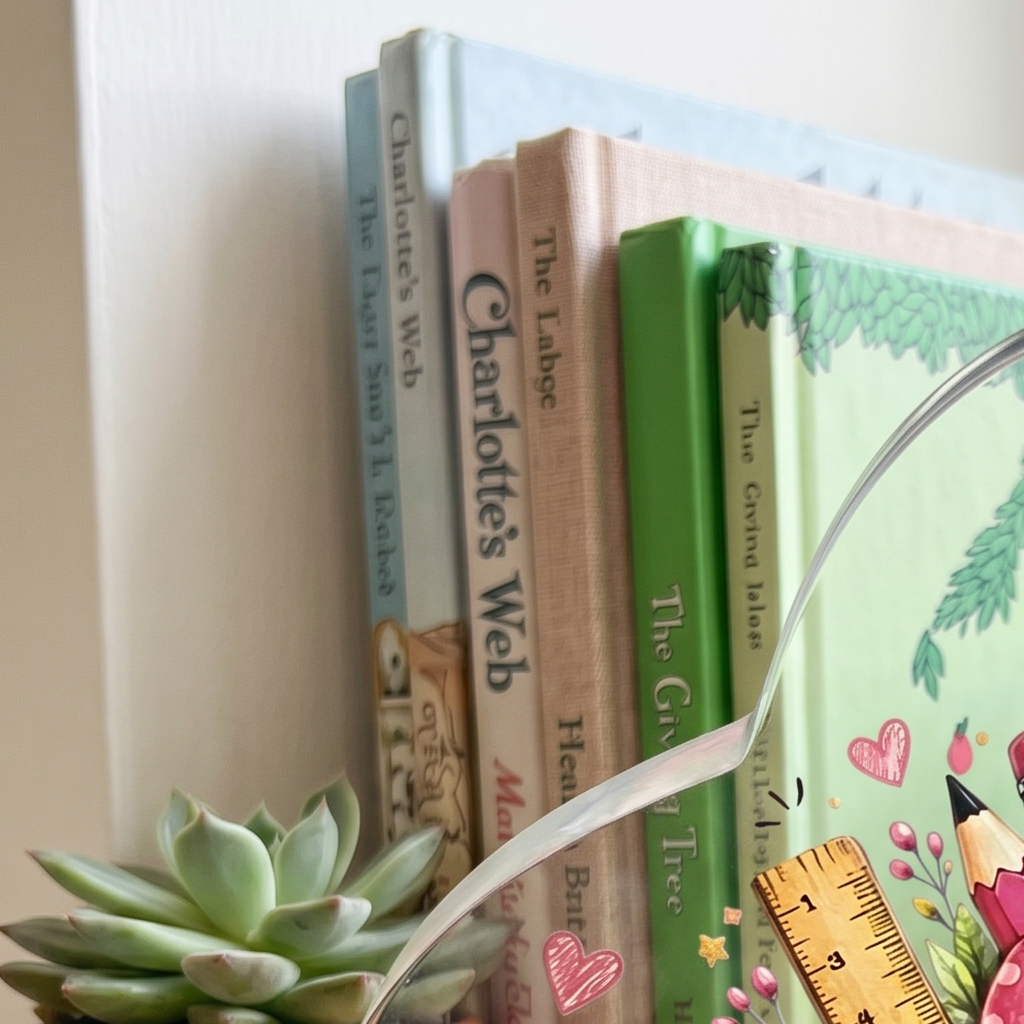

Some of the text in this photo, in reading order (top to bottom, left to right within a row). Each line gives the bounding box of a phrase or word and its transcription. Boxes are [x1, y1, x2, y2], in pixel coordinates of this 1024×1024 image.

[389, 112, 425, 390] Charlotte's Web
[533, 227, 558, 296] The
[461, 273, 531, 694] Charlotte's Web
[650, 583, 698, 916] The Givg Tree
[799, 894, 817, 914] 1
[826, 951, 846, 971] 3
